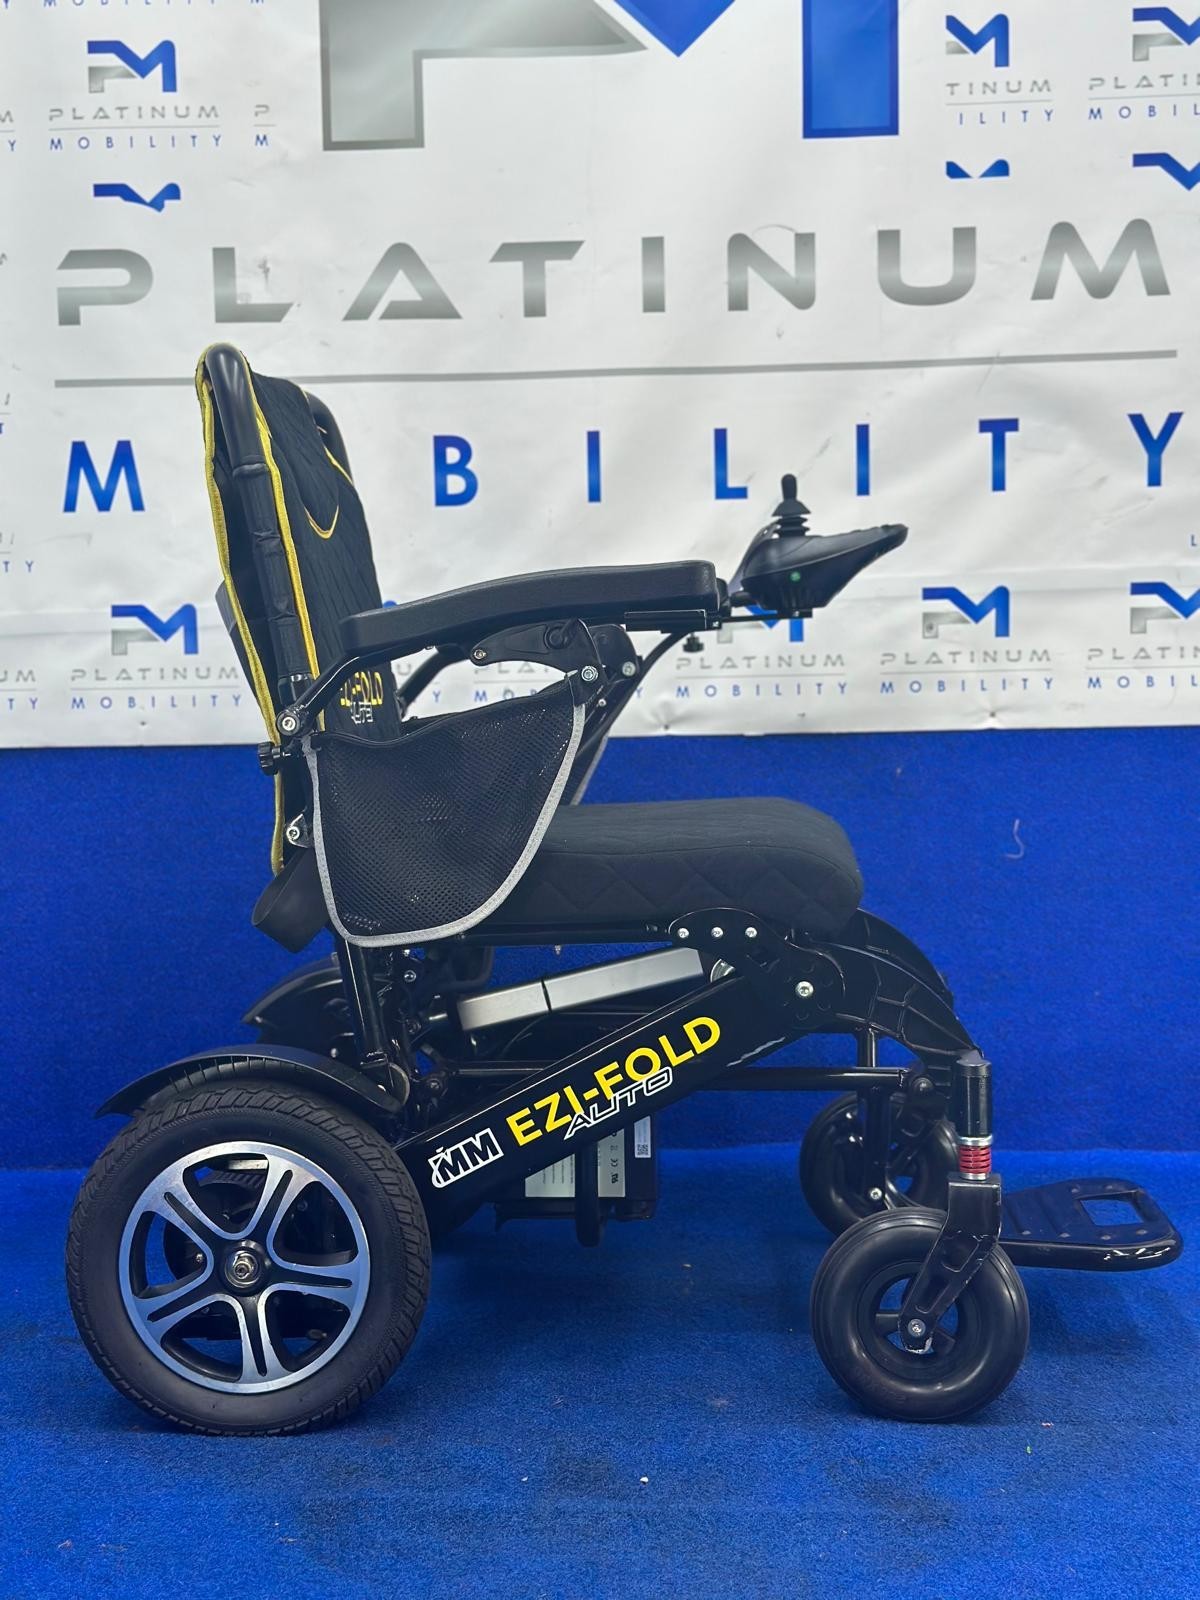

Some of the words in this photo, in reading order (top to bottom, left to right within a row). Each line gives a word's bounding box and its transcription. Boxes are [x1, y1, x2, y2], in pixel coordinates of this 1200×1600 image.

[48, 105, 220, 122] PLATINUM
[50, 134, 222, 150] MOBILITY
[57, 218, 1171, 326] PLATINUM
[63, 411, 1184, 513] MBILITY
[675, 654, 846, 671] PLATINUM
[880, 648, 1052, 666] PLATINUM
[70, 666, 240, 682] PLATINUM
[675, 681, 848, 698] MOBILITY
[880, 677, 1053, 694] MOBILITY
[71, 694, 241, 710] MOBILITY
[505, 1016, 721, 1147] EZI-FOLD
[563, 1066, 674, 1141] AUTO
